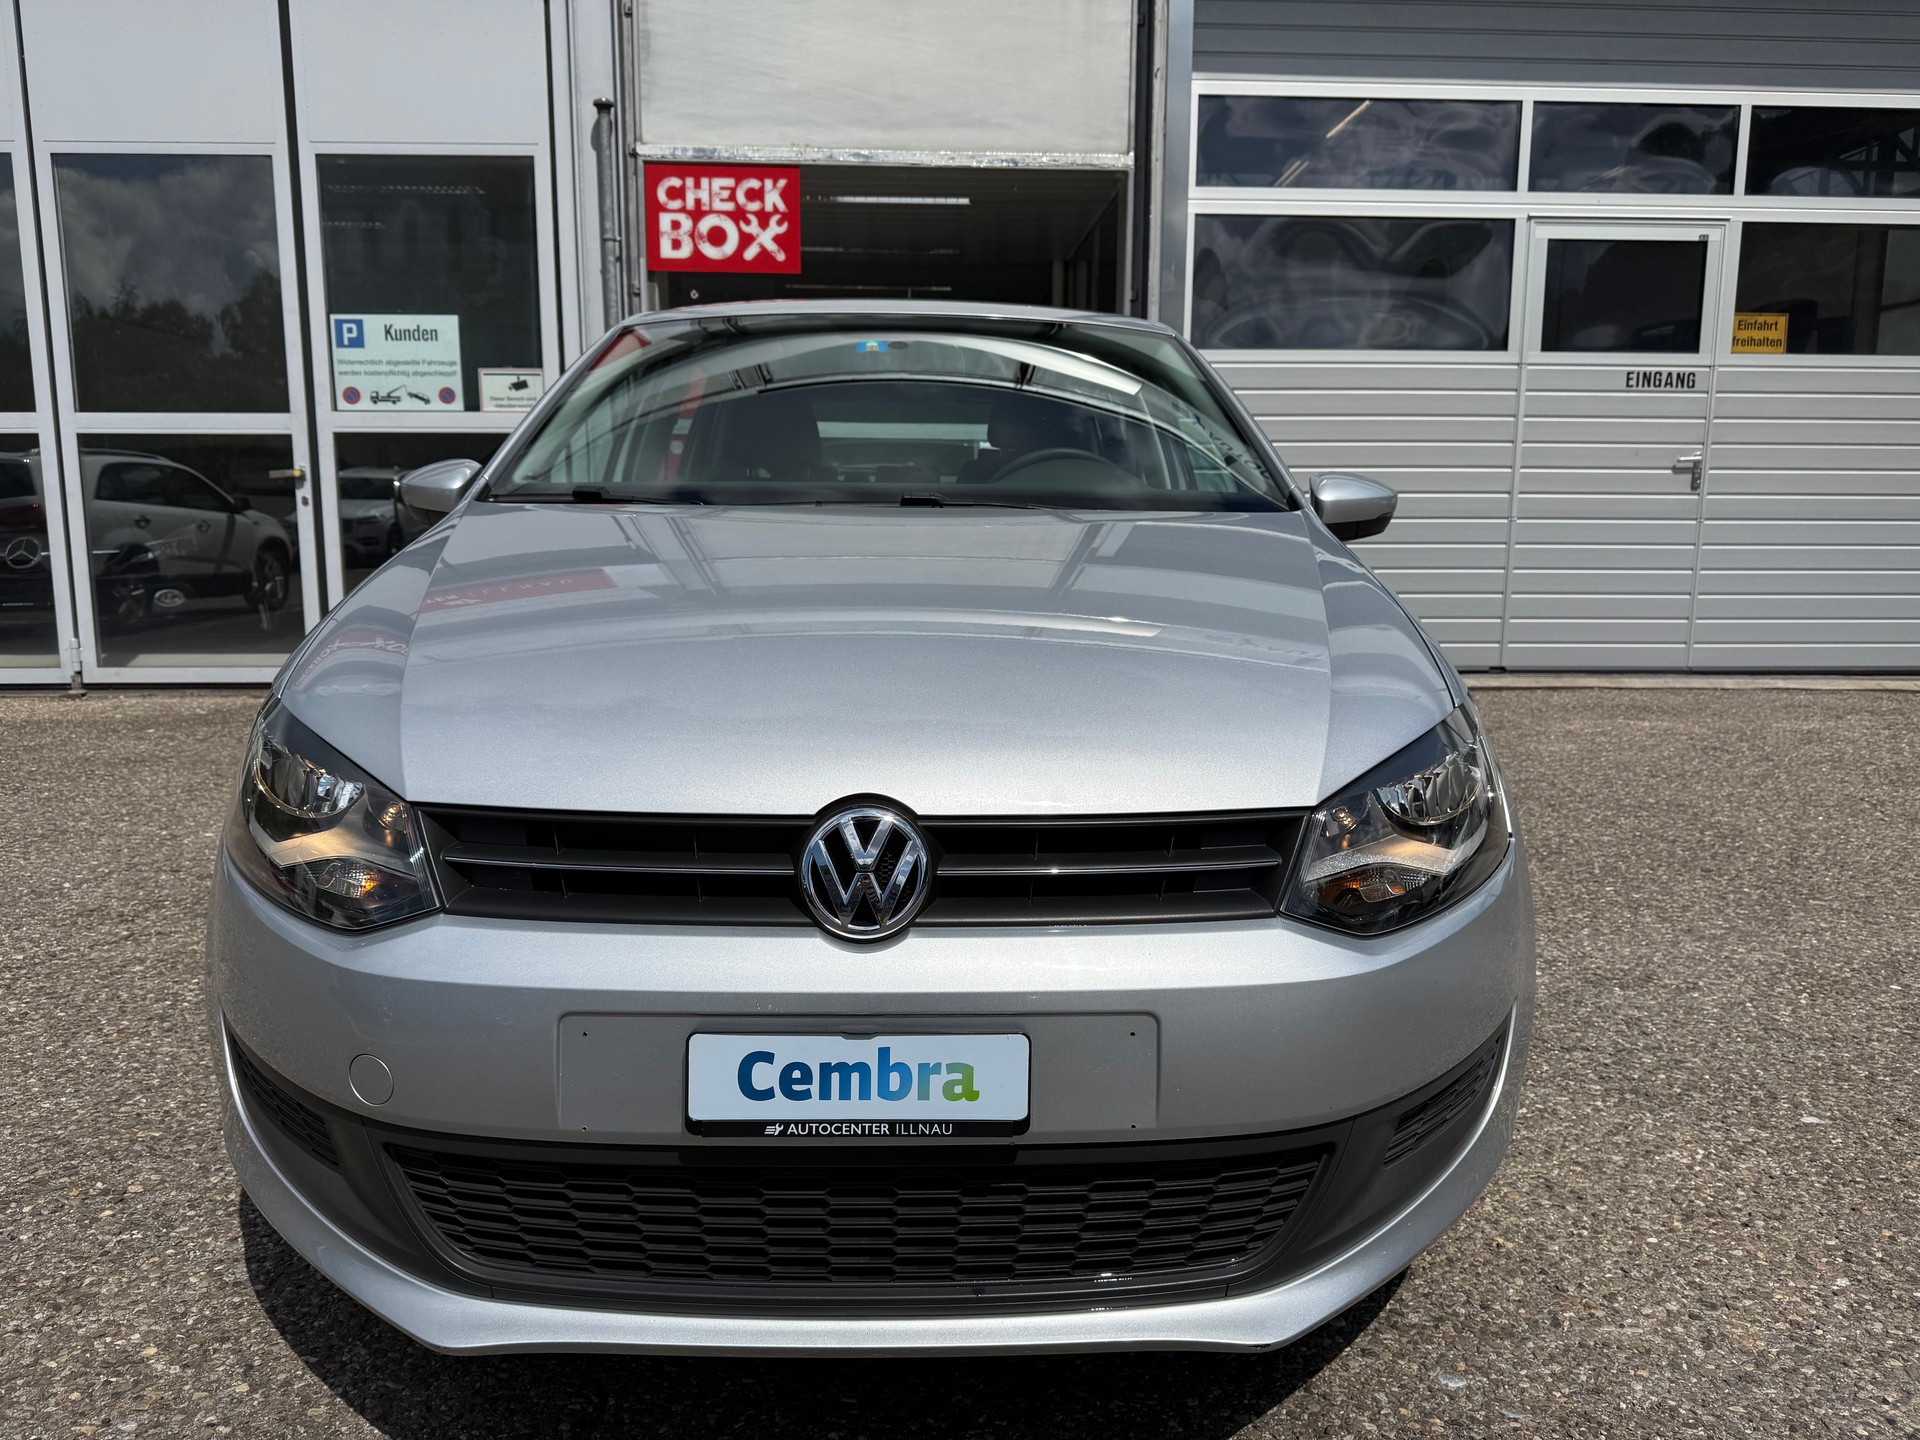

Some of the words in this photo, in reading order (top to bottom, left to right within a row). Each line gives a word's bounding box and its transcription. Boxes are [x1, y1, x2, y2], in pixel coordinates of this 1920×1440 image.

[656, 176, 789, 213] CHECK
[658, 211, 788, 262] BOX
[342, 322, 359, 346] P
[384, 324, 438, 342] Kunden
[1737, 319, 1779, 332] Einfahrt
[1732, 335, 1783, 348] freihalten
[422, 359, 457, 368] Fahrzeuge
[1625, 371, 1696, 389] EINGANG
[737, 1046, 980, 1102] Cembra
[787, 1123, 890, 1136] AUTOCENTER
[896, 1123, 953, 1136] ILLNAU
